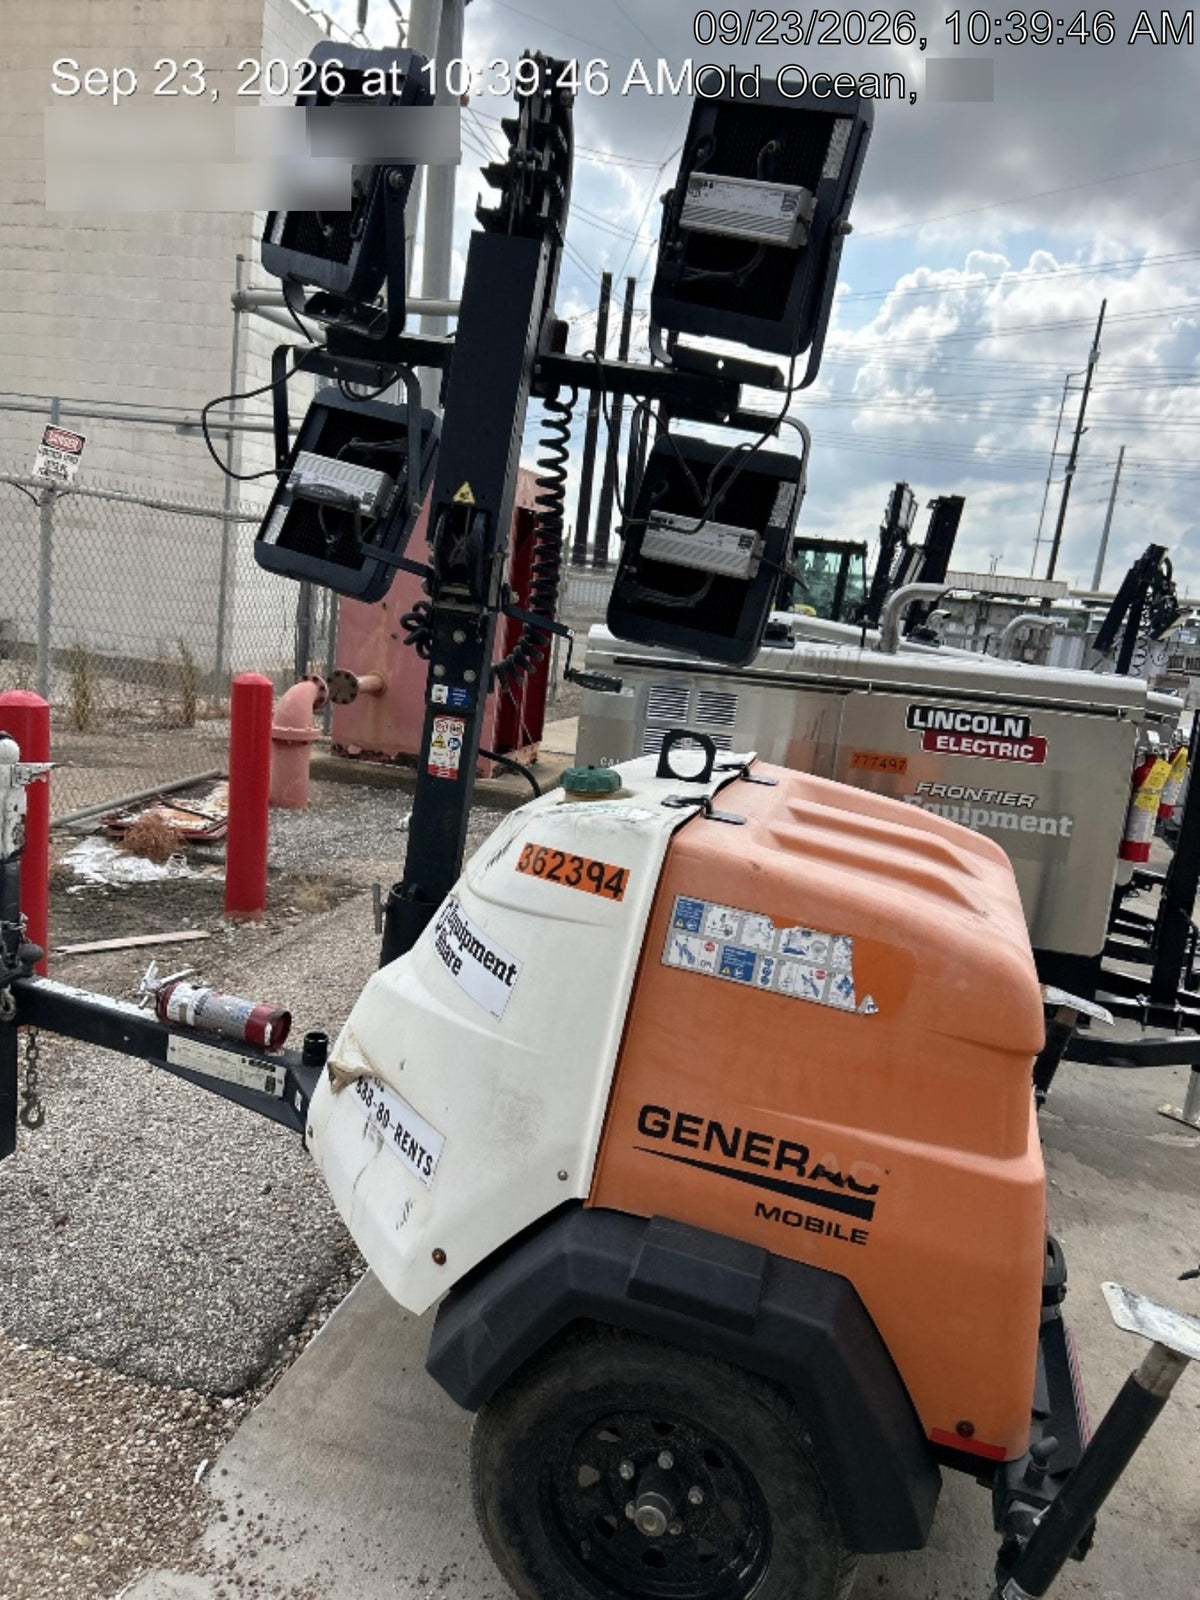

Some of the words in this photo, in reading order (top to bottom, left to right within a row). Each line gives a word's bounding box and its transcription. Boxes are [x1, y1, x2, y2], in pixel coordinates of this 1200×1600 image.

[912, 708, 1025, 738] LINCOLN
[936, 735, 1034, 759] ELECTRIC
[914, 780, 1037, 809] FRONTIER
[518, 843, 625, 899] 362394
[753, 1201, 870, 1246] MOBILE
